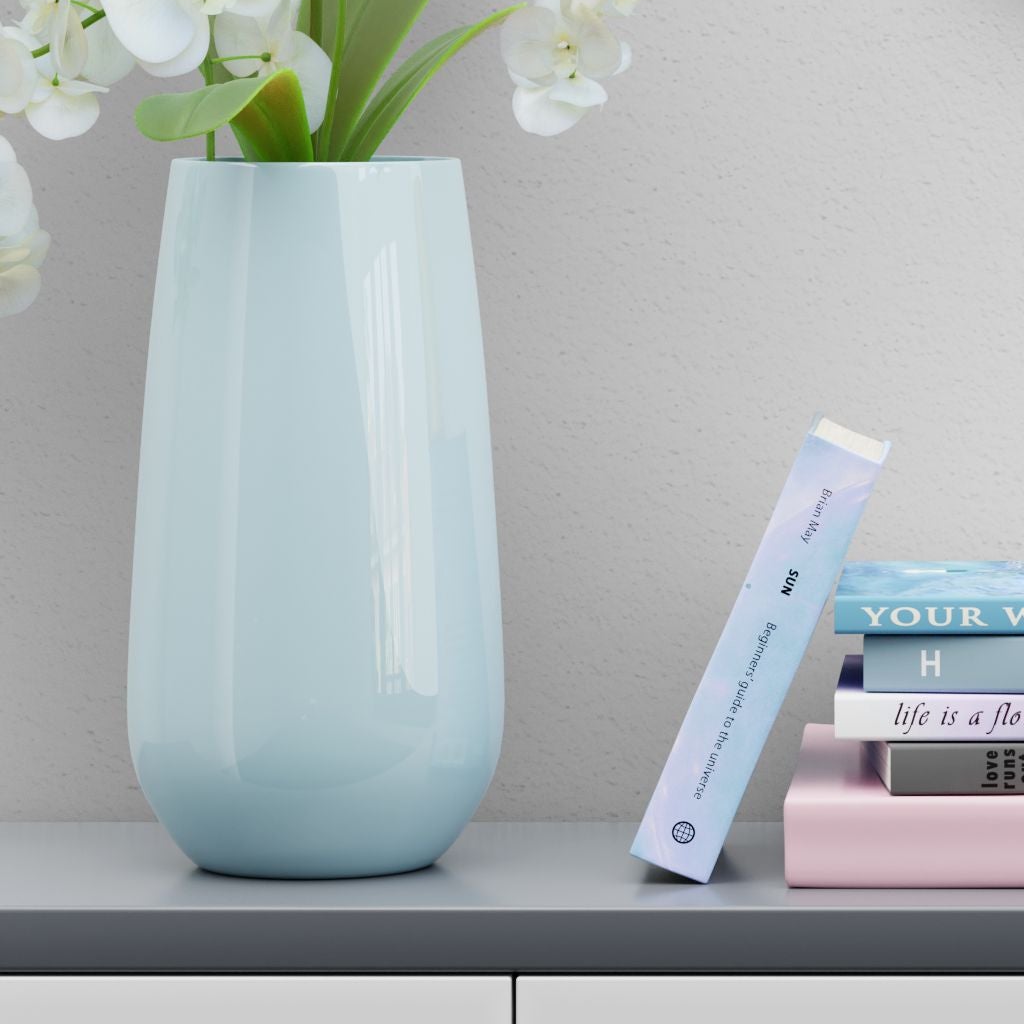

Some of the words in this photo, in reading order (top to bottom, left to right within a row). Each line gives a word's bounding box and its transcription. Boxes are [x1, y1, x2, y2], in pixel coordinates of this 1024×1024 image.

[812, 488, 833, 518] Brian
[800, 519, 820, 545] May
[781, 568, 799, 597] SUN
[860, 606, 989, 627] YOUR
[745, 621, 777, 682] Beginners'
[729, 680, 749, 714] guide
[723, 717, 735, 728] to
[894, 702, 930, 734] life
[941, 706, 958, 726] is
[968, 710, 984, 726] a
[714, 731, 729, 750] the
[693, 753, 719, 800] universe
[981, 750, 999, 788] love
[1003, 748, 1016, 789] runs
